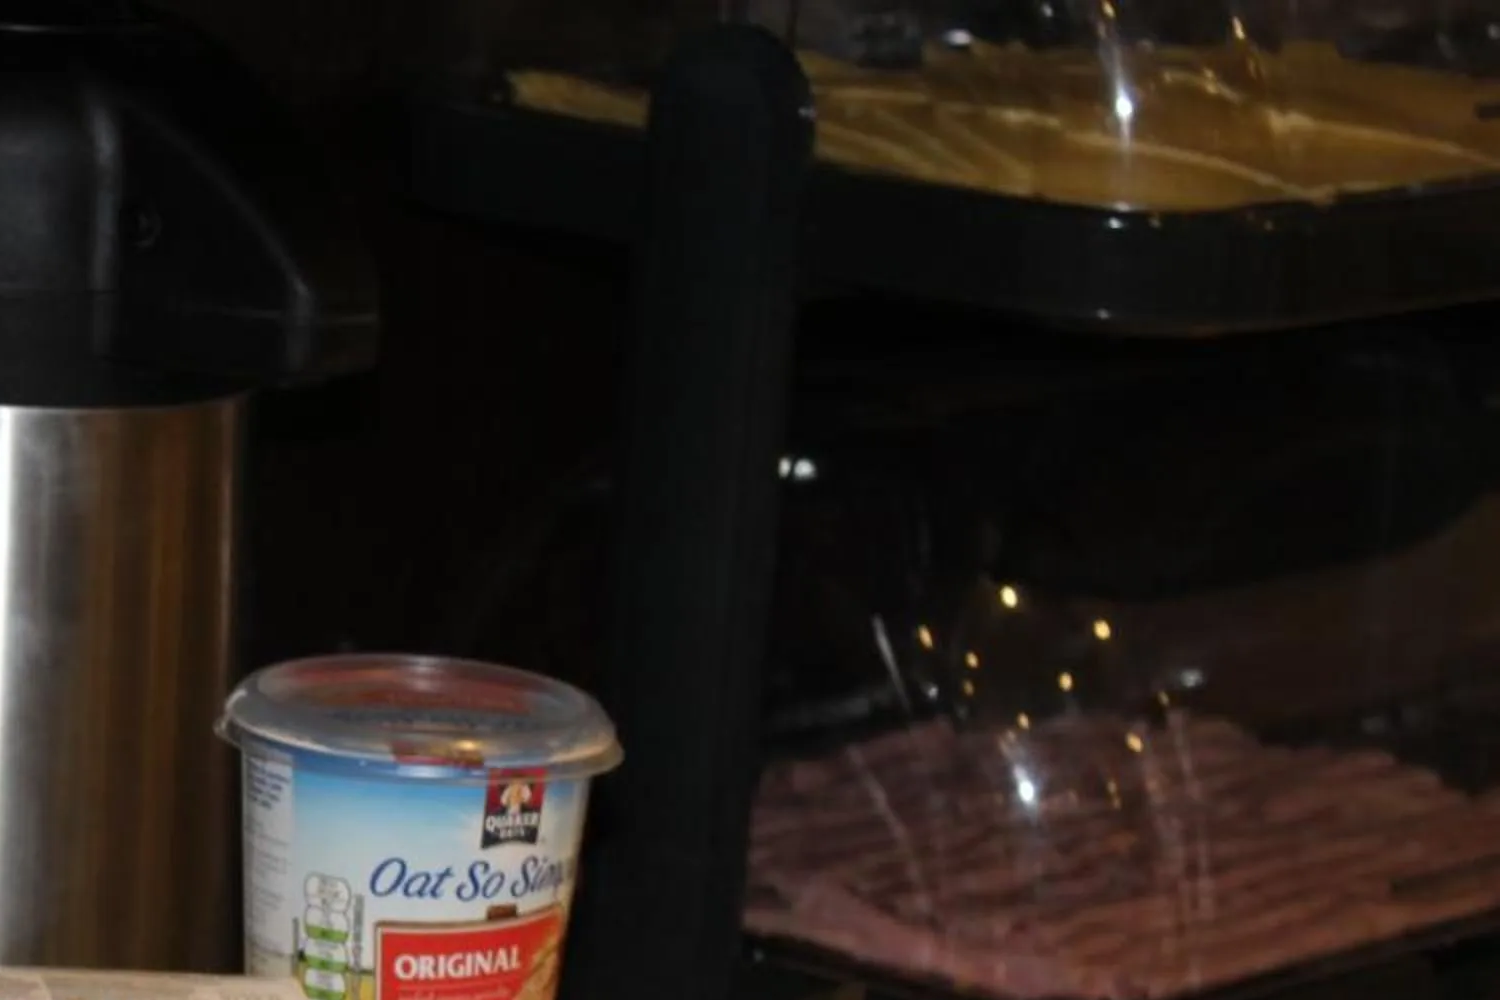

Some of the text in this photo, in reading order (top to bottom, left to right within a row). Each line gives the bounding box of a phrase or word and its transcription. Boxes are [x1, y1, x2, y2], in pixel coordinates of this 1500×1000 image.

[369, 857, 454, 900] Oat
[455, 859, 506, 902] So
[393, 944, 521, 981] ORIGINAL
